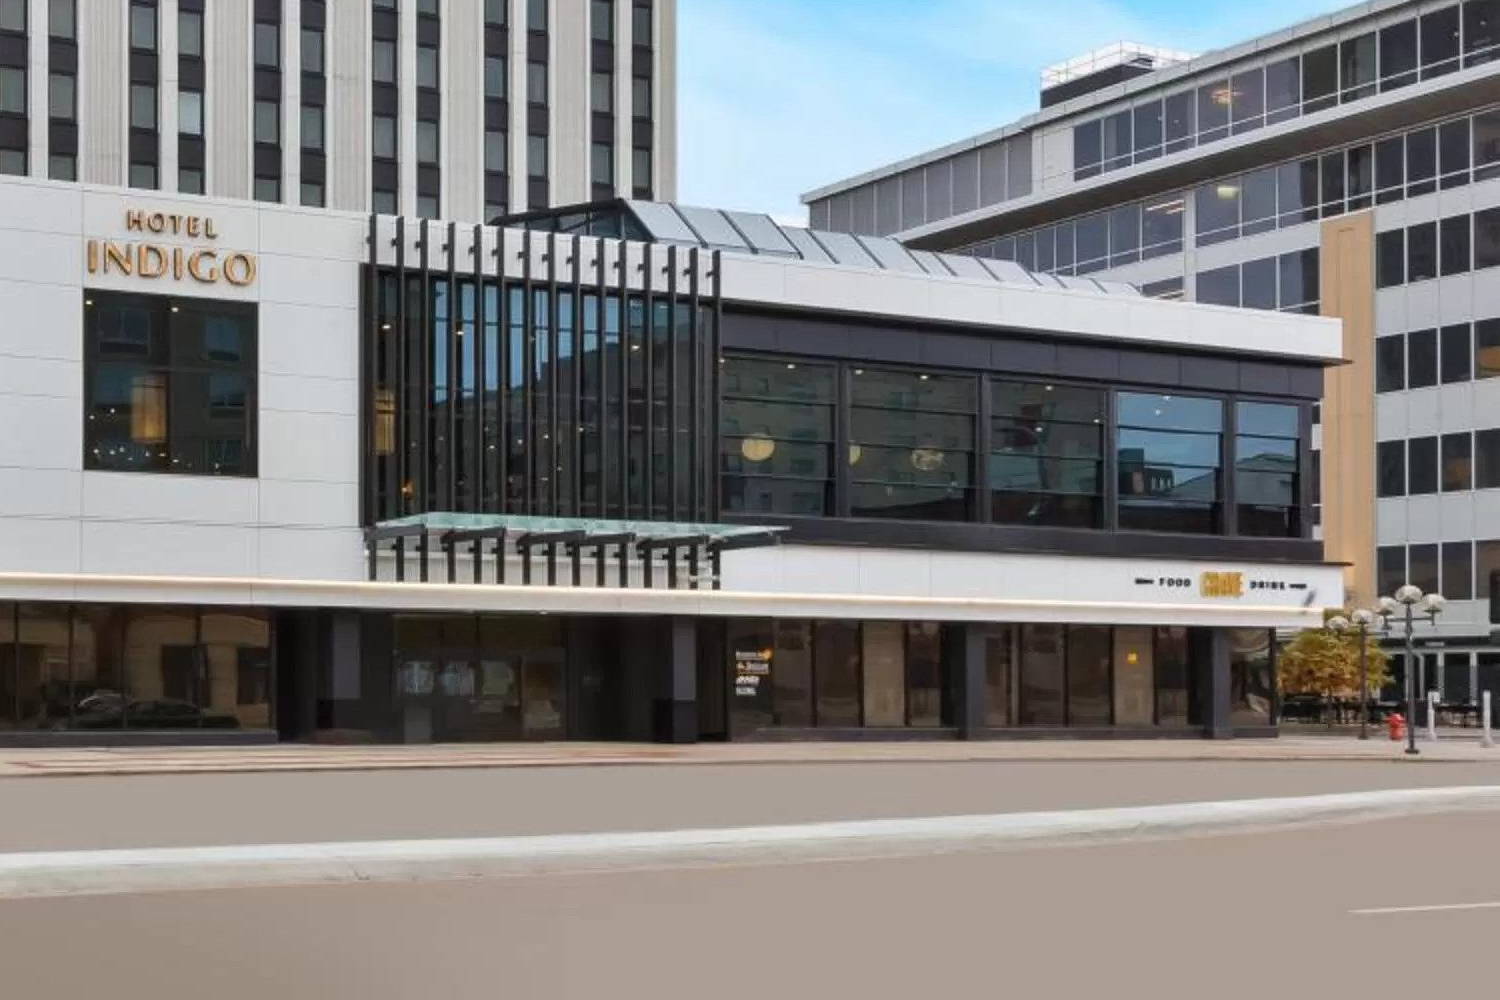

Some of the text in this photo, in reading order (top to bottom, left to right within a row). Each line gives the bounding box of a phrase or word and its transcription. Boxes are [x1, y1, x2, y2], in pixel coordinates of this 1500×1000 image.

[127, 210, 218, 238] HOTEL
[88, 240, 256, 285] INDIGO
[1159, 578, 1191, 587] FOOD
